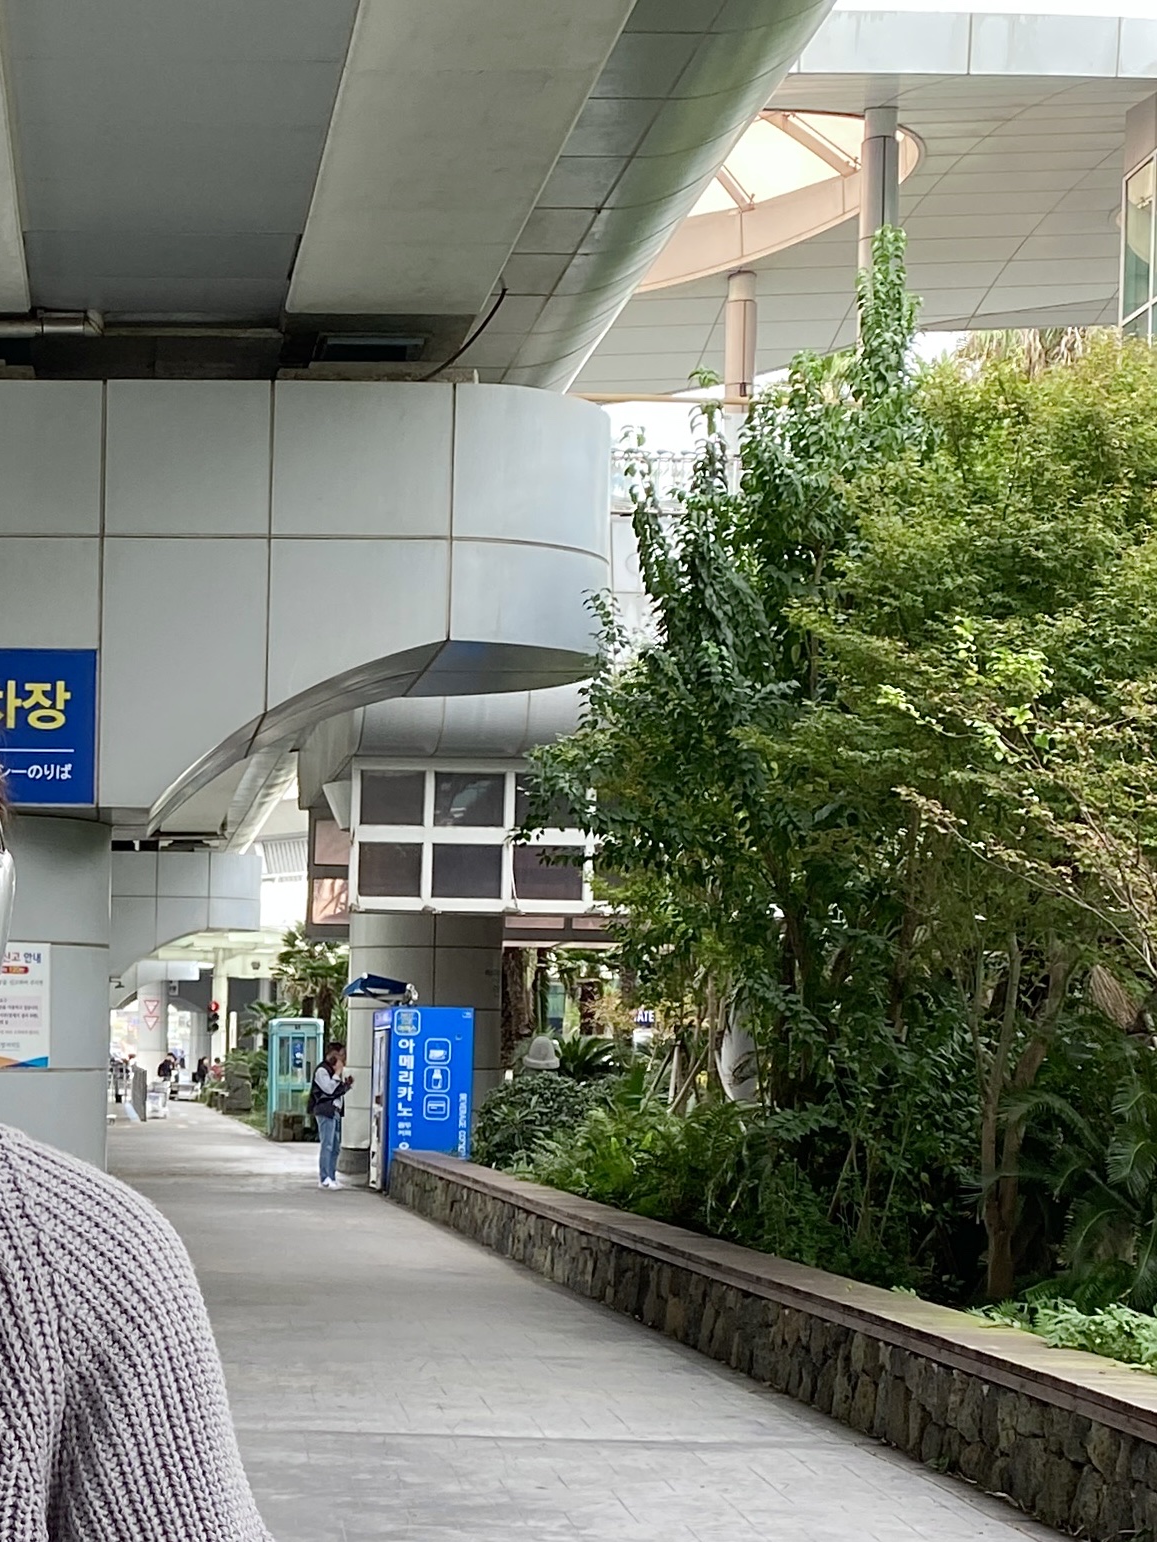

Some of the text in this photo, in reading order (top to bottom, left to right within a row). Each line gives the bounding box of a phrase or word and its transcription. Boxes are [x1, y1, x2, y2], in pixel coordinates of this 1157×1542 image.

[24, 952, 42, 963] 안내
[634, 1010, 655, 1022] ATE
[397, 1038, 416, 1117] 아메리카노
